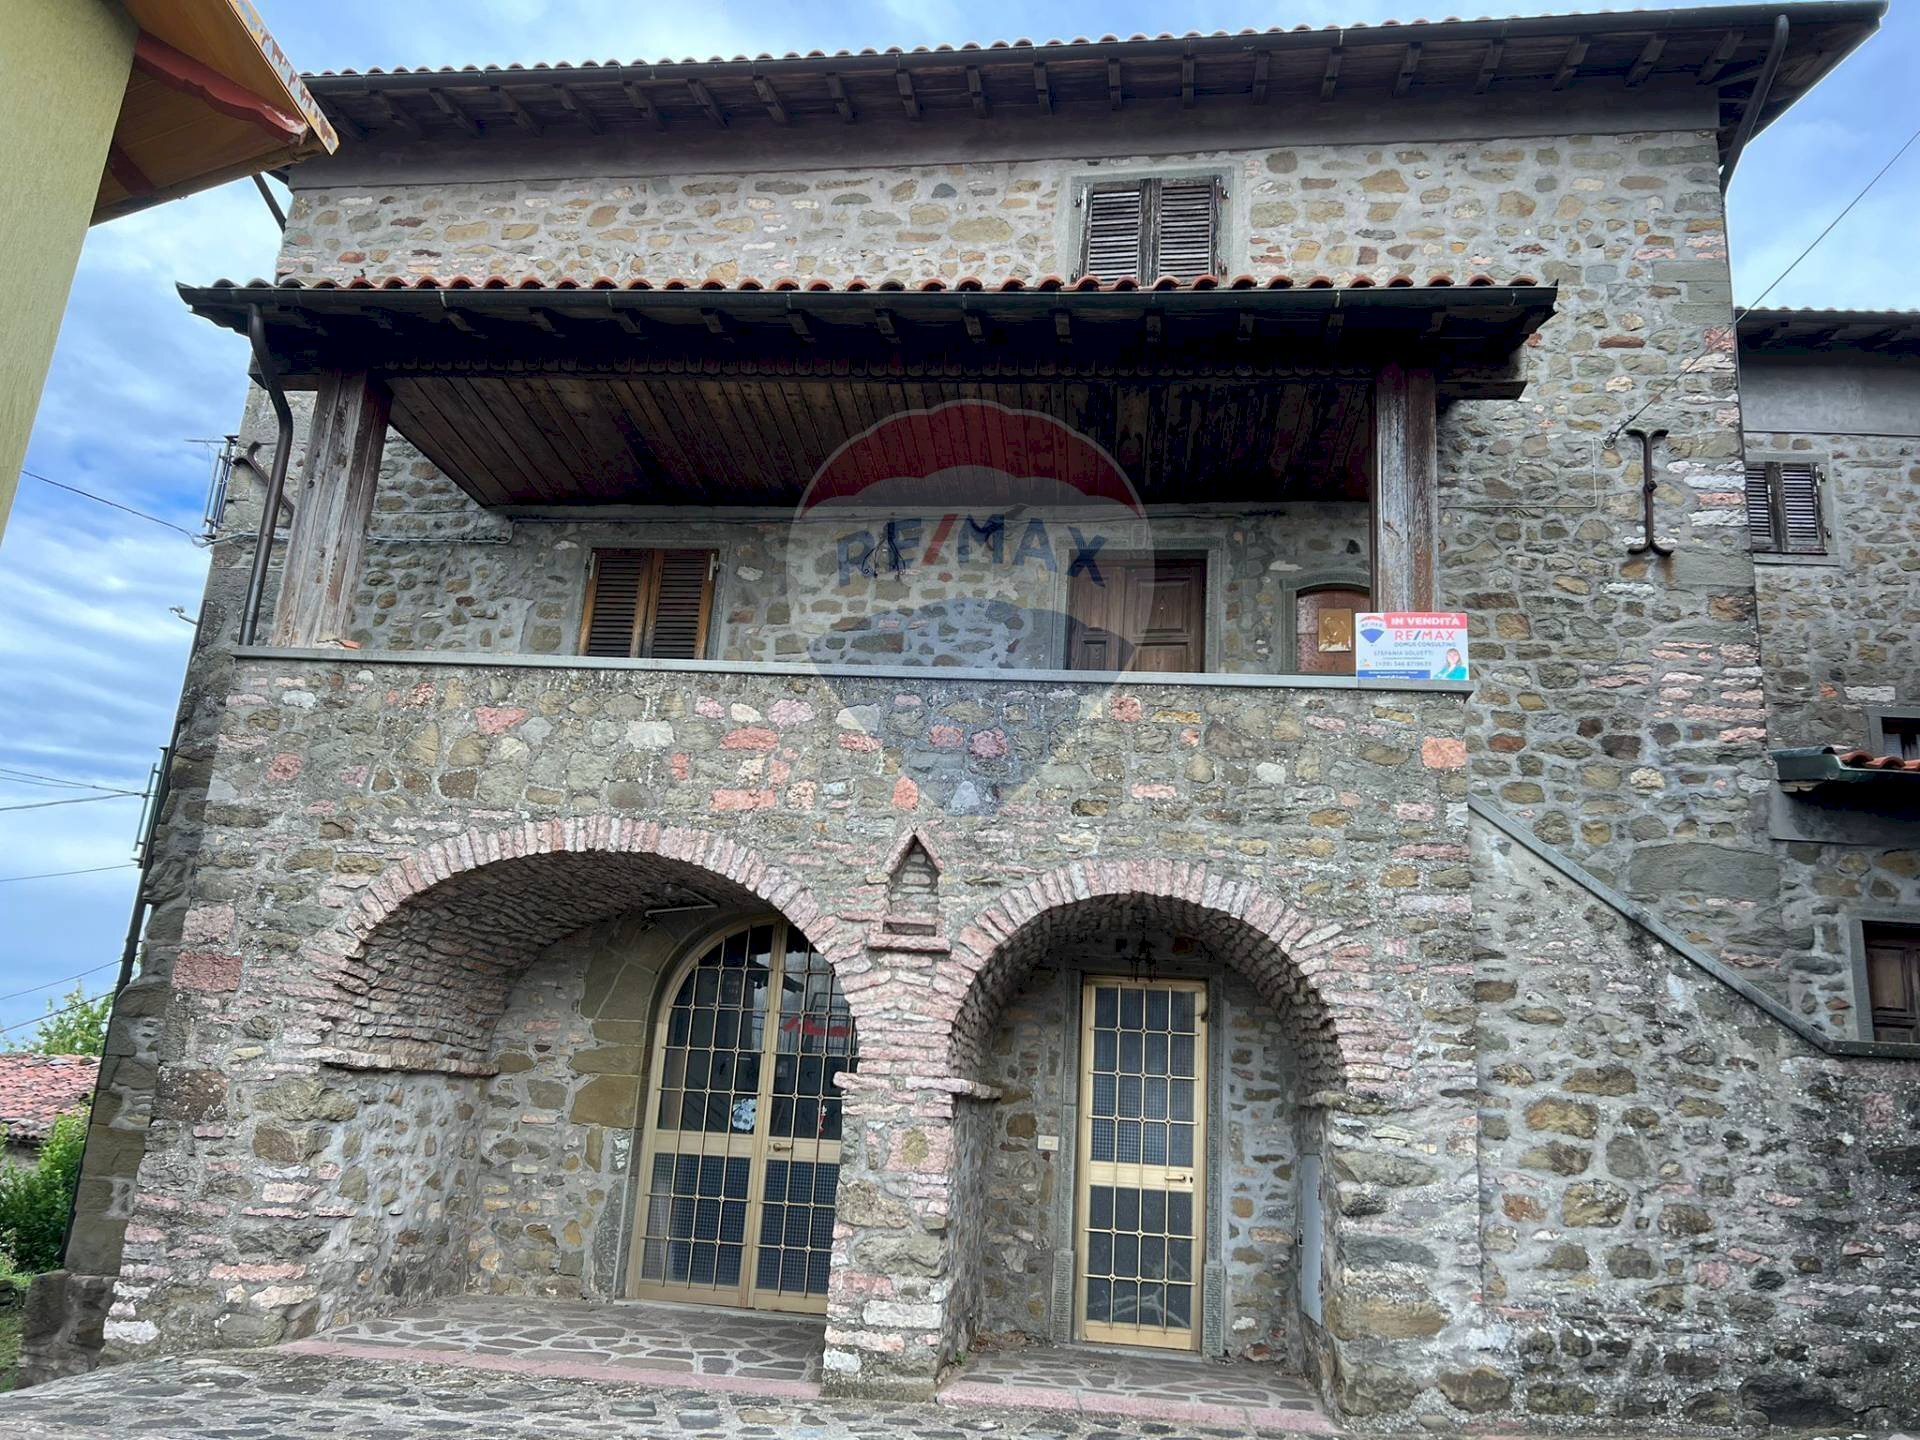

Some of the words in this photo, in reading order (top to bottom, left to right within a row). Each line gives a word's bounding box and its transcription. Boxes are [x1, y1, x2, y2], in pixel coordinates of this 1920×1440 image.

[1391, 617, 1404, 625] IN
[1407, 614, 1460, 625] VENDITÀ
[1394, 630, 1455, 641] RE/MAX
